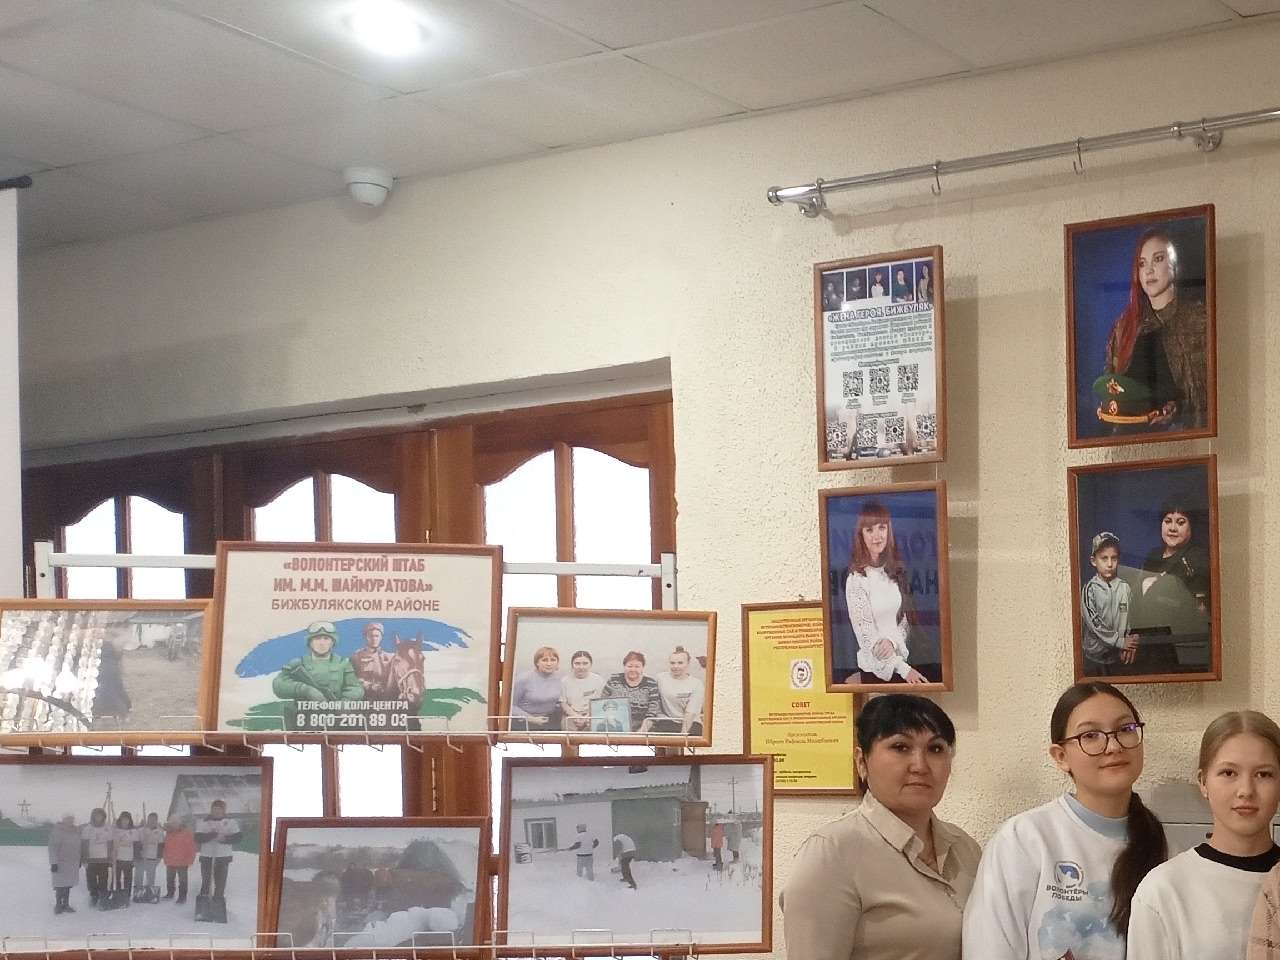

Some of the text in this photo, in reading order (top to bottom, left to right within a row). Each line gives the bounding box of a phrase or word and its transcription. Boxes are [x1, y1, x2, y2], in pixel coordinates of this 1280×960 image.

[885, 302, 933, 316] БИЖБУЛЯК»
[283, 555, 425, 572] «ВОЛОНТЕРСКИЙ ШТАБ
[273, 576, 433, 593] ИМ. М.М. ШАЙМУРАТОВА»
[271, 597, 440, 611] БИЖБУЛЯКСКОМ РАЙОНЕ
[297, 701, 409, 711] ТЕЛЕФОН КОЛЛ-ЦЕНТРА
[296, 714, 408, 727] 8 800 201 89 03
[1052, 893, 1082, 901] ПОБЕДЫ
